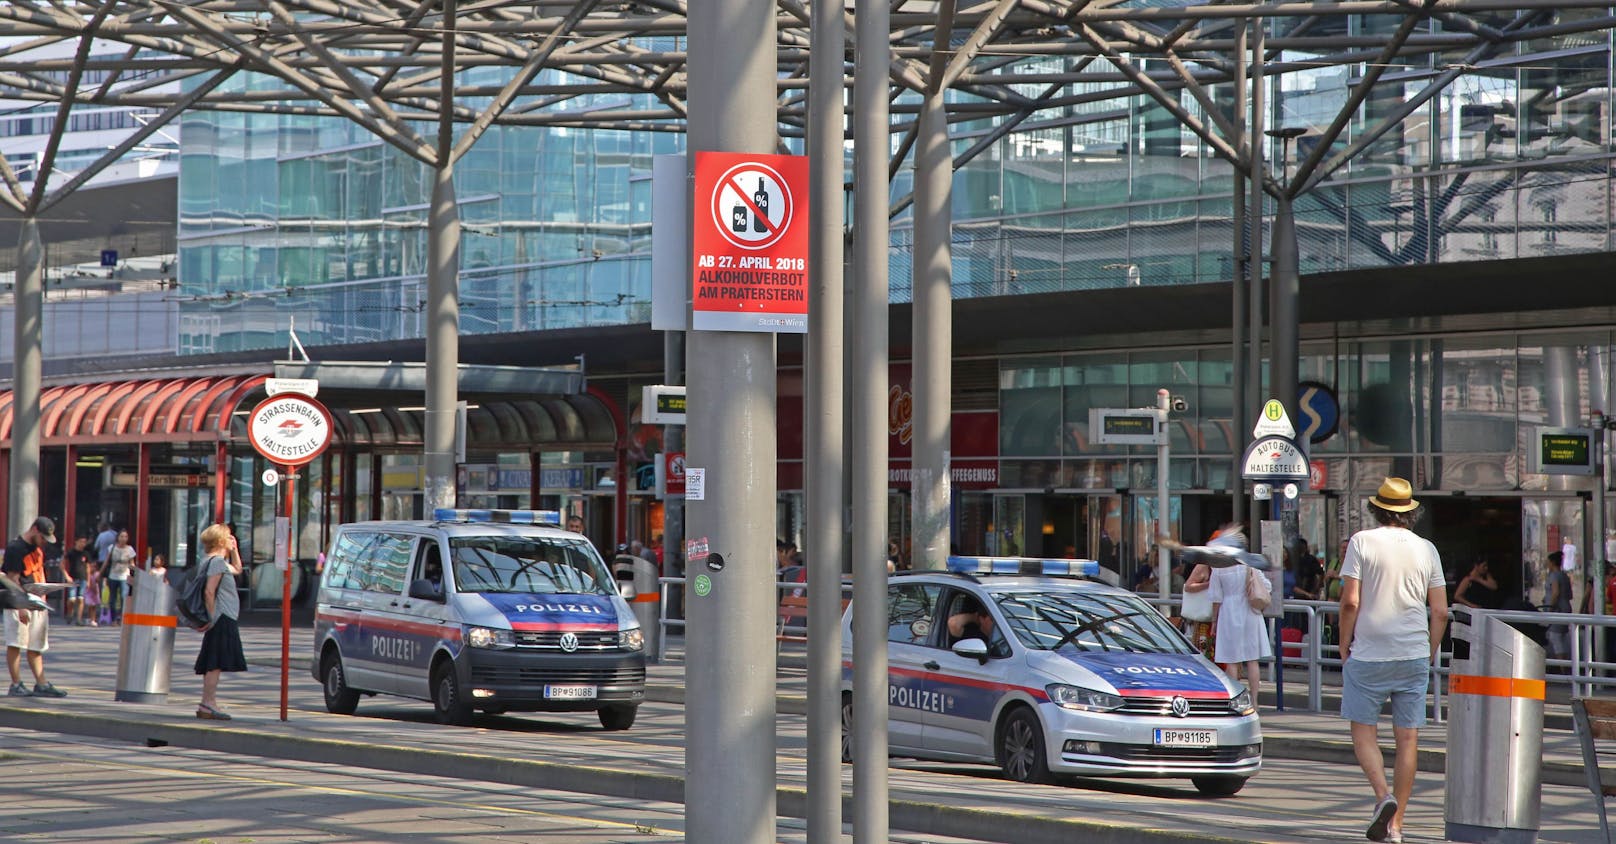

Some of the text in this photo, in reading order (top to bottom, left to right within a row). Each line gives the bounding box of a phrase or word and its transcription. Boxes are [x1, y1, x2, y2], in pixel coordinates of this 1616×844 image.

[698, 255, 805, 271] AB 27. APRIL 2018
[698, 270, 805, 286] ALKOHOLVERBOT
[698, 286, 804, 301] AM PRATERSTERN
[259, 403, 323, 428] STRASSENBAHN
[1269, 404, 1279, 417] H
[261, 435, 319, 457] HALTESTELLE
[1257, 441, 1295, 457] AUTOBUS
[951, 467, 996, 482] FFEEGENUSS
[1250, 463, 1302, 473] HALTESTELLE
[515, 604, 601, 614] POLIZEI
[372, 634, 414, 661] POLIZEI
[1113, 666, 1198, 676] POLIZEI
[889, 685, 945, 713] POLIZEI
